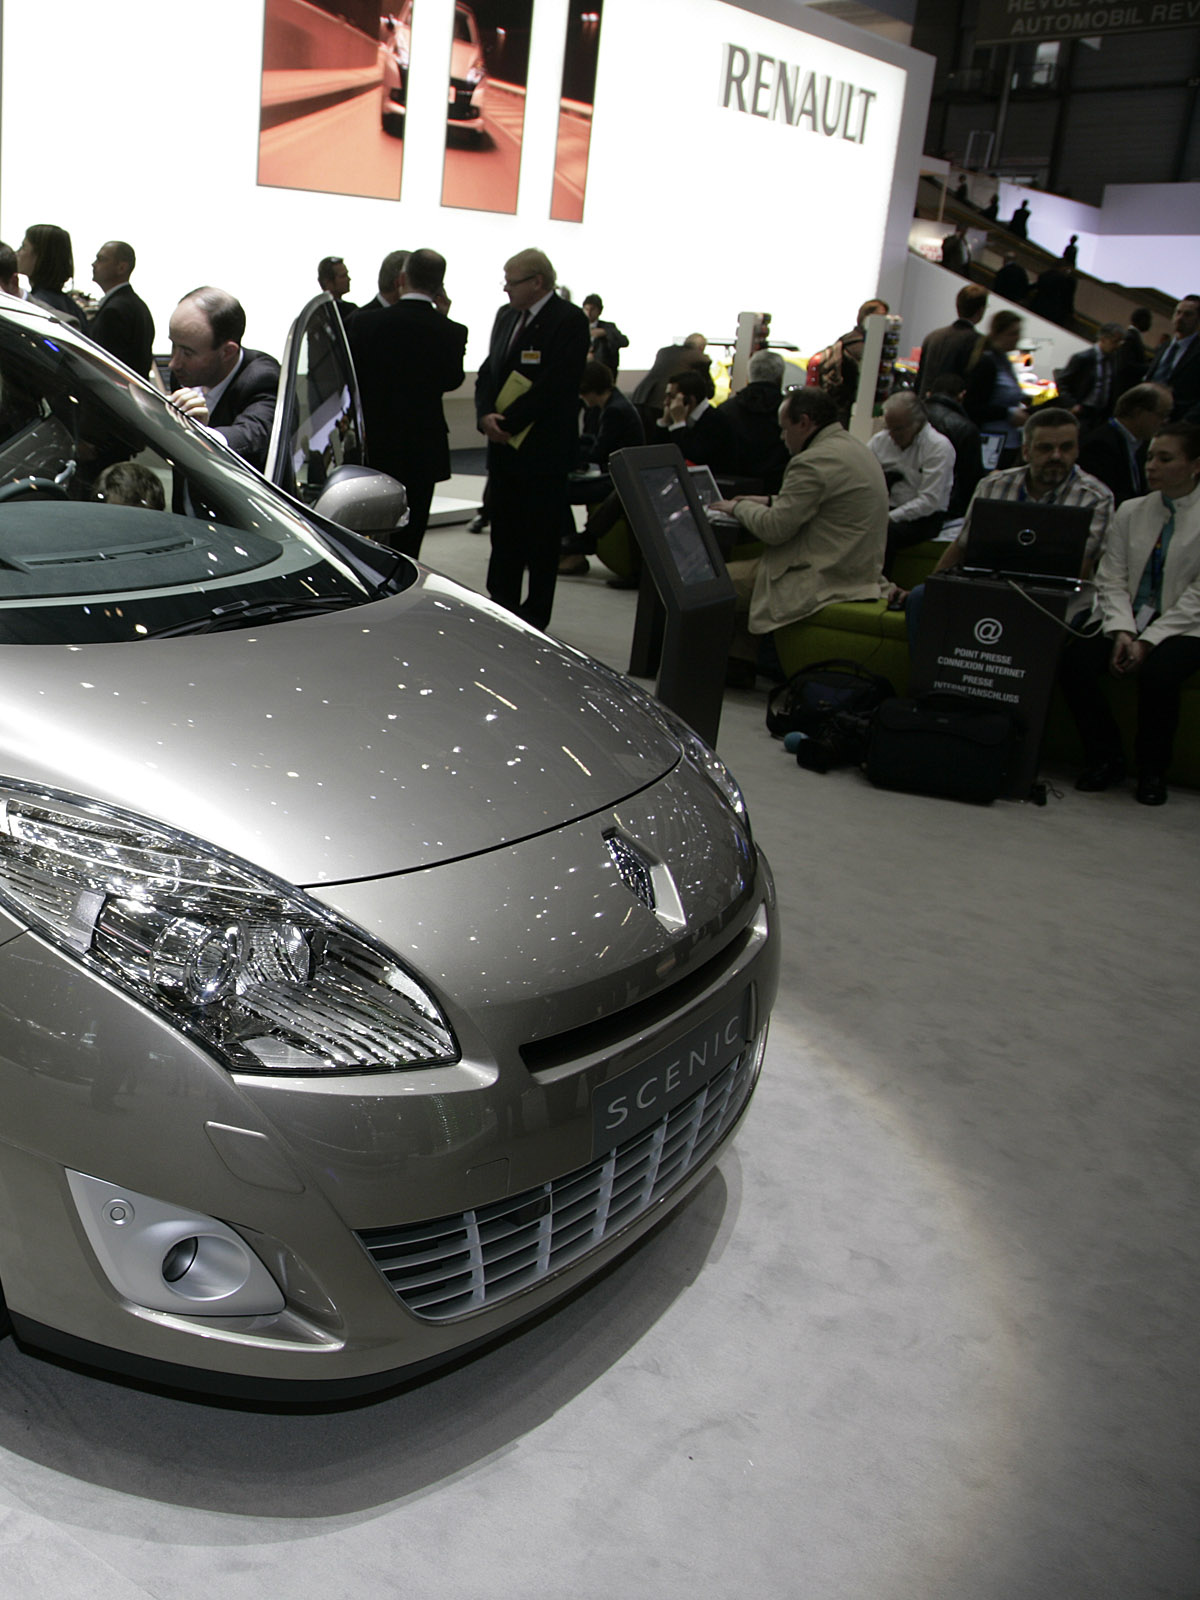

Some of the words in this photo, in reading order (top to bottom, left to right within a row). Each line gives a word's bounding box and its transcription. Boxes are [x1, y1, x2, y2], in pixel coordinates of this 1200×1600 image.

[1010, 7, 1144, 36] AUTOMOBIL
[719, 43, 877, 145] RENAULT
[937, 656, 984, 671] CONNEXION
[986, 664, 1026, 679] INTERNET
[954, 647, 979, 659] POINT
[980, 651, 1012, 665] PRESSE
[962, 674, 994, 688] PRESSE
[605, 1016, 739, 1130] SCENIC
